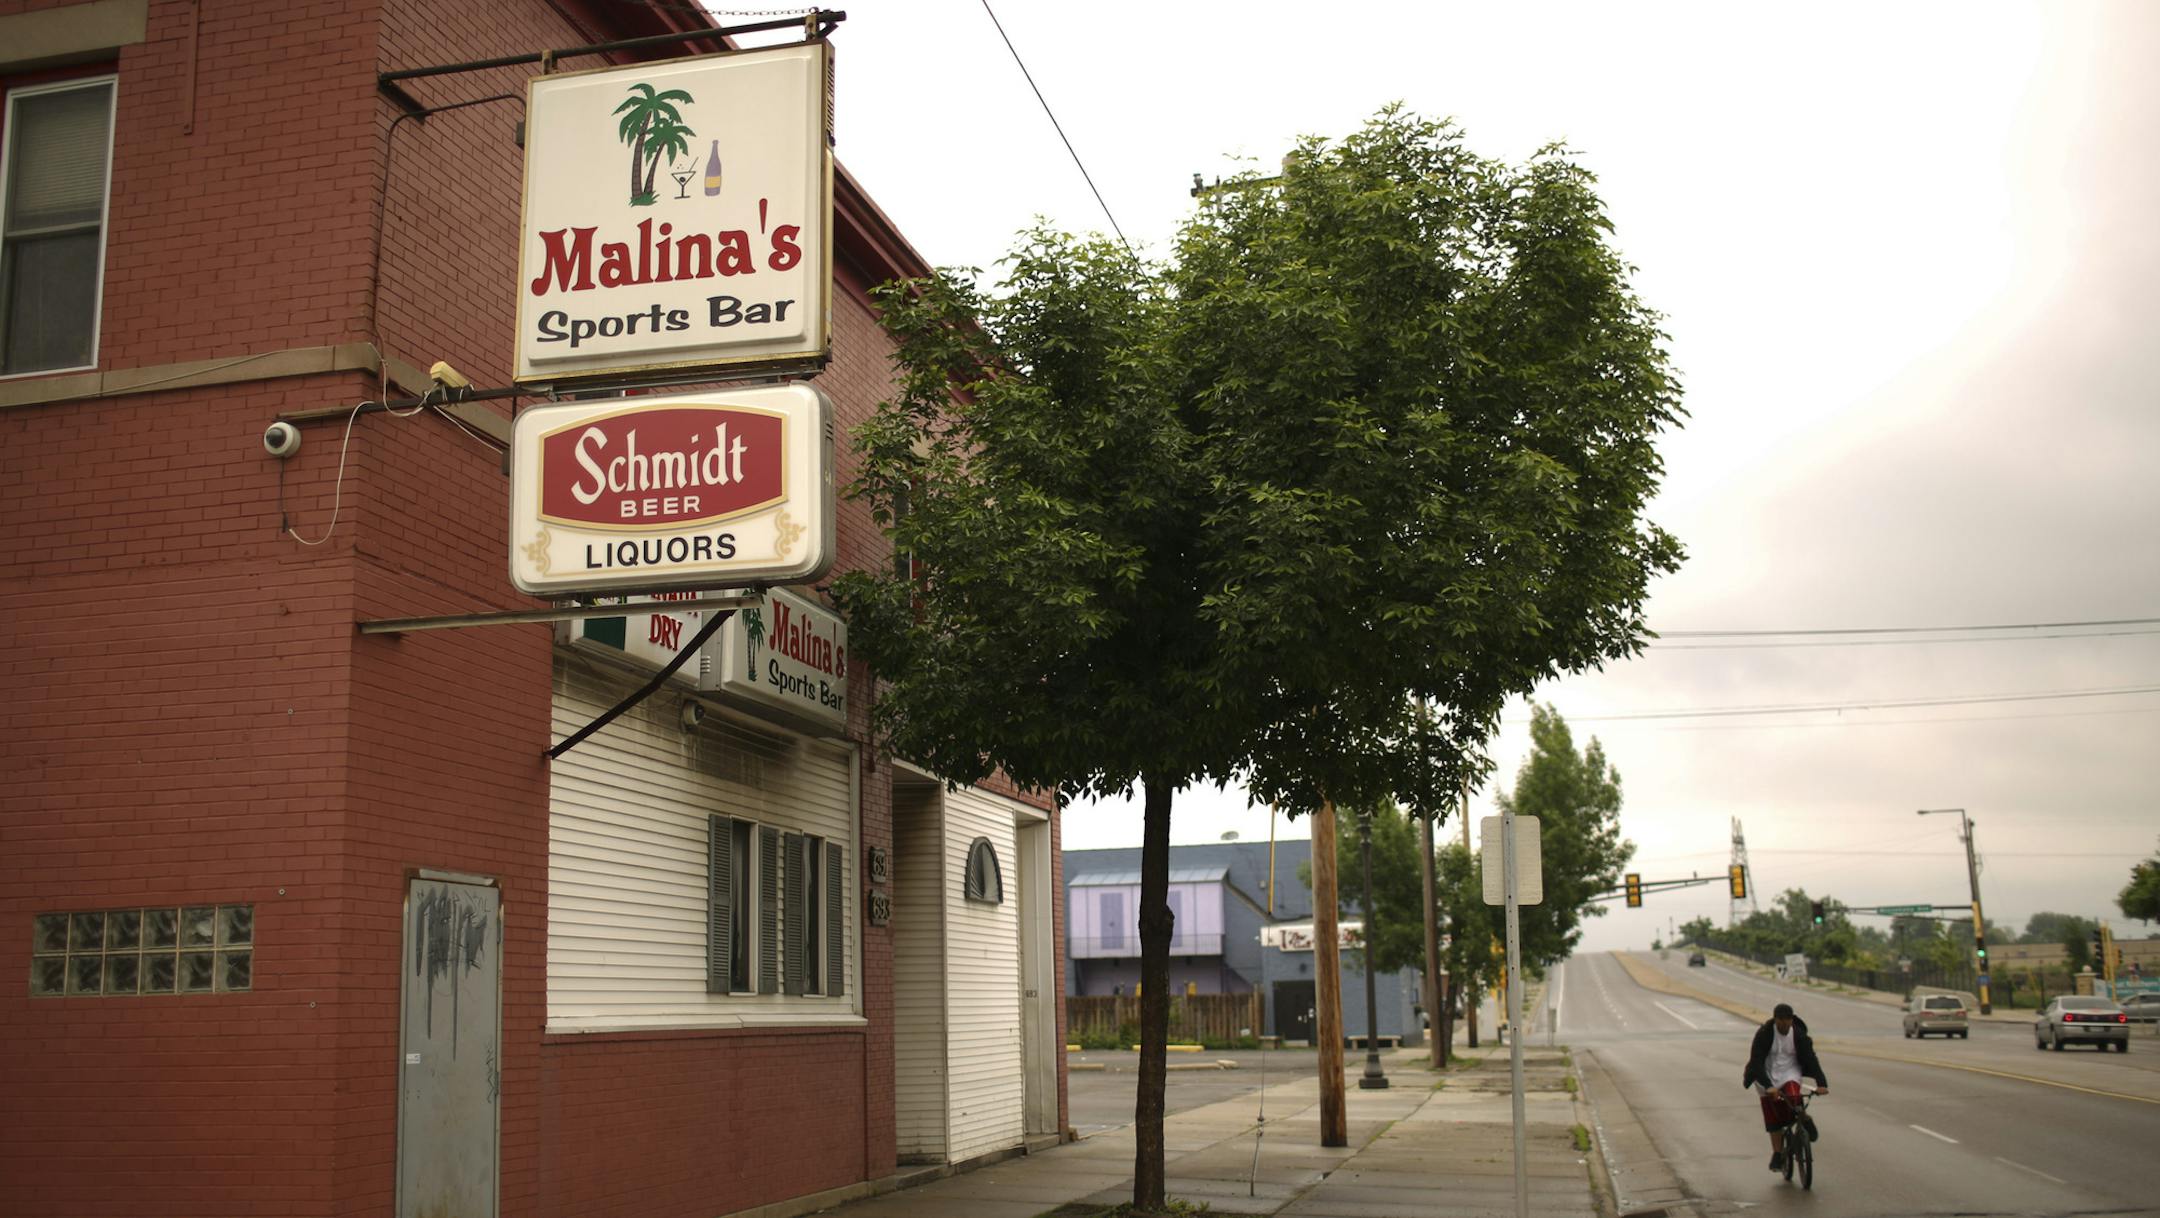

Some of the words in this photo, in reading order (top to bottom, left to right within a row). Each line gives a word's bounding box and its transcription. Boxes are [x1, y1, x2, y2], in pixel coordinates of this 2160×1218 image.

[531, 198, 801, 297] Malina's
[536, 304, 690, 348] Sports
[706, 295, 796, 328] Bar
[571, 421, 748, 505] Schmidt
[620, 495, 701, 518] BEER
[585, 533, 737, 569] LIQUORS
[649, 613, 683, 652] DRY
[769, 598, 845, 680] Malina's
[768, 658, 816, 701] Sports
[820, 679, 843, 711] Bar
